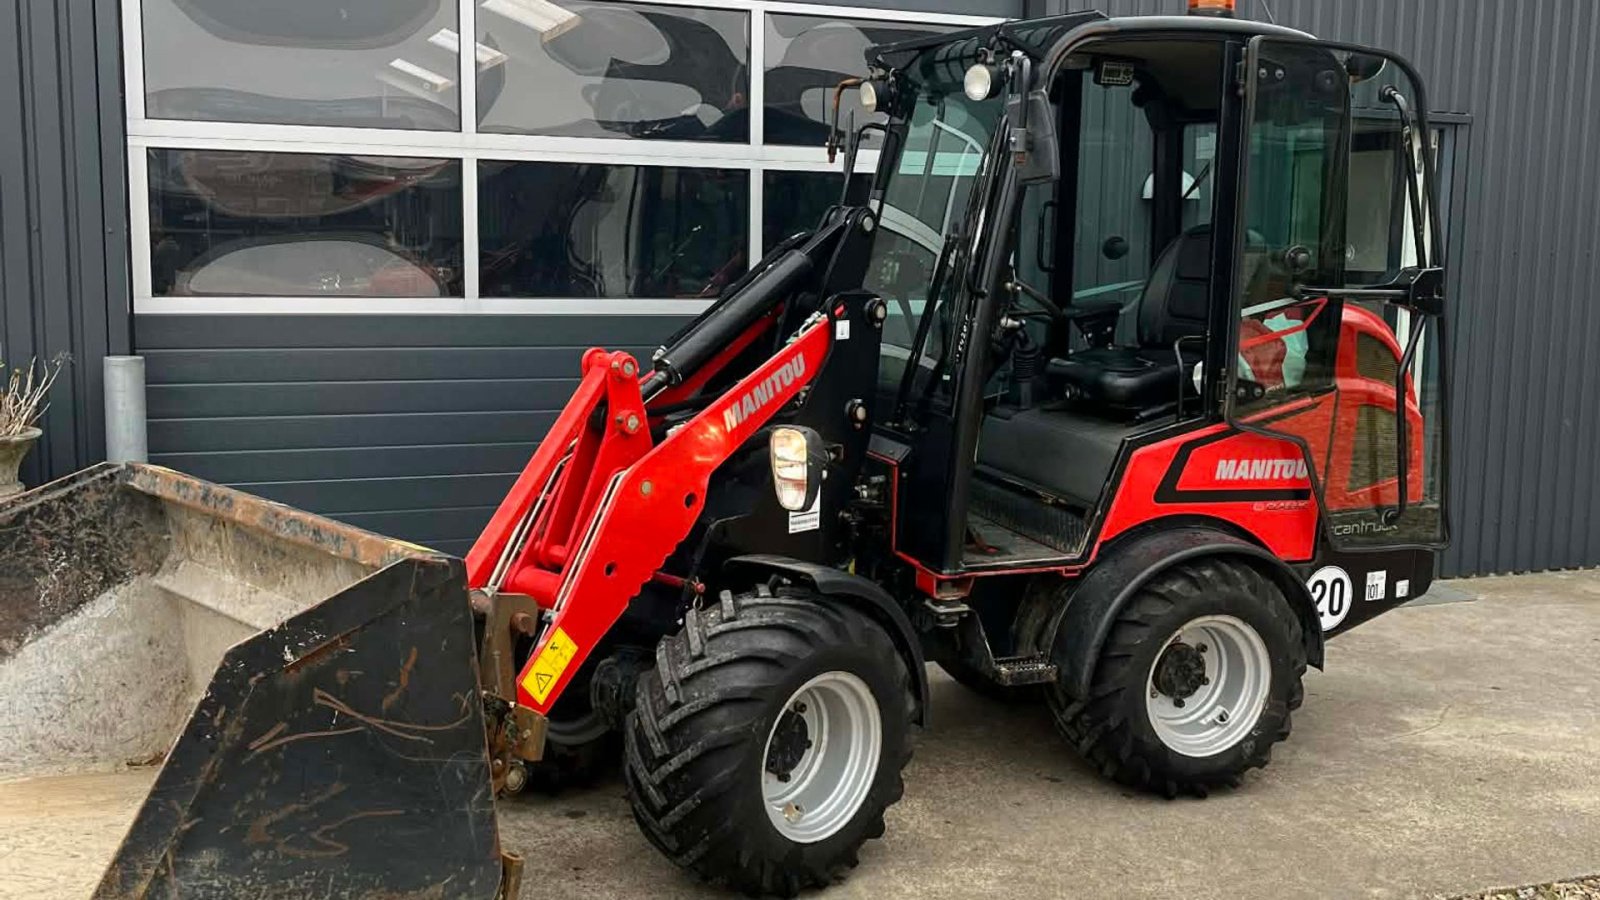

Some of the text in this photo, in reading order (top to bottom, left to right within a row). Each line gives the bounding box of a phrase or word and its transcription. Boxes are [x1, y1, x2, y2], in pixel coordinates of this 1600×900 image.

[723, 352, 806, 433] MANITOU
[1215, 459, 1308, 480] MANITOU
[1311, 577, 1345, 617] 20
